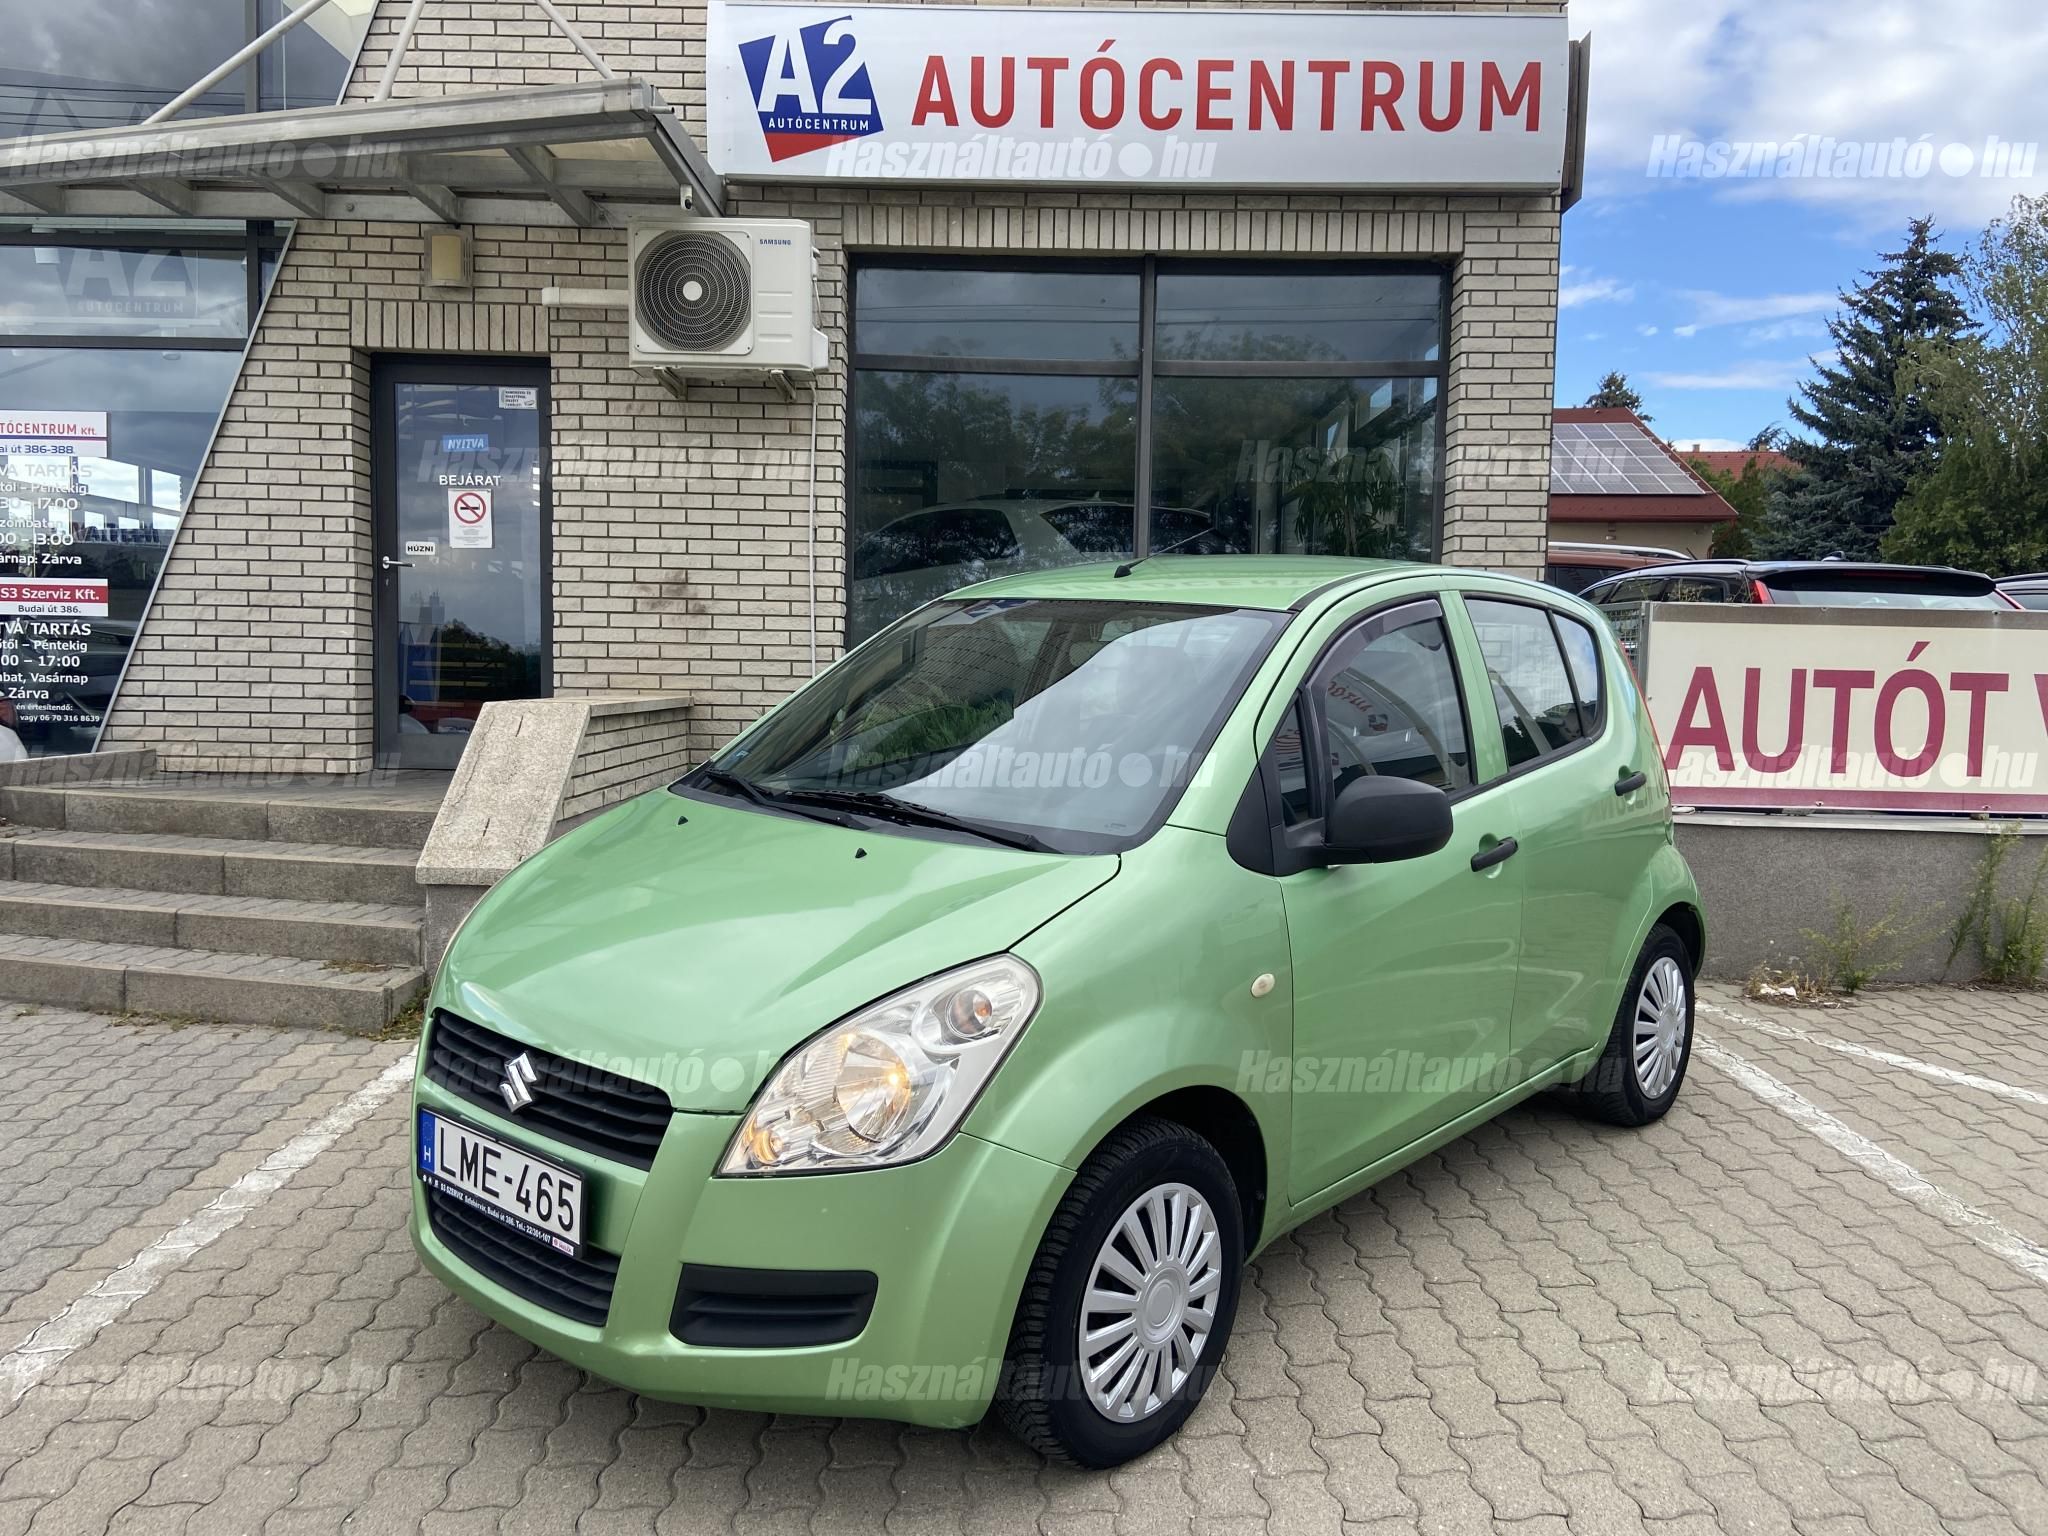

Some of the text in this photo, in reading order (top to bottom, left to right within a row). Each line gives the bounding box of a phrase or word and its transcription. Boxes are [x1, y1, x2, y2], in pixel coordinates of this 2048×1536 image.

[757, 19, 872, 115] A2
[911, 39, 1542, 133] AUTÓCENTRUM
[768, 116, 870, 132] AUTÓCENTRUM
[759, 238, 792, 246] SAMSUNG
[11, 444, 22, 454] út
[447, 438, 485, 450] NYITVA
[438, 472, 502, 486] BEJÁRAT
[33, 533, 74, 546] 13:00
[407, 544, 434, 552] HÚZNI
[41, 553, 82, 565] Zárva
[0, 587, 100, 600] S3 Szerviz Kft.
[18, 604, 82, 614] Budai út 386.
[30, 619, 92, 636] TARTÁS
[33, 639, 88, 653] Péntekig
[38, 655, 81, 668] 17:00
[0, 671, 89, 686] bat, Vasárnap
[8, 686, 49, 700] Zárva
[1665, 640, 2010, 778] AUTÓT
[63, 714, 79, 722] 316
[80, 715, 100, 723] 8639
[423, 1145, 431, 1163] H
[440, 1126, 574, 1232] LME-465
